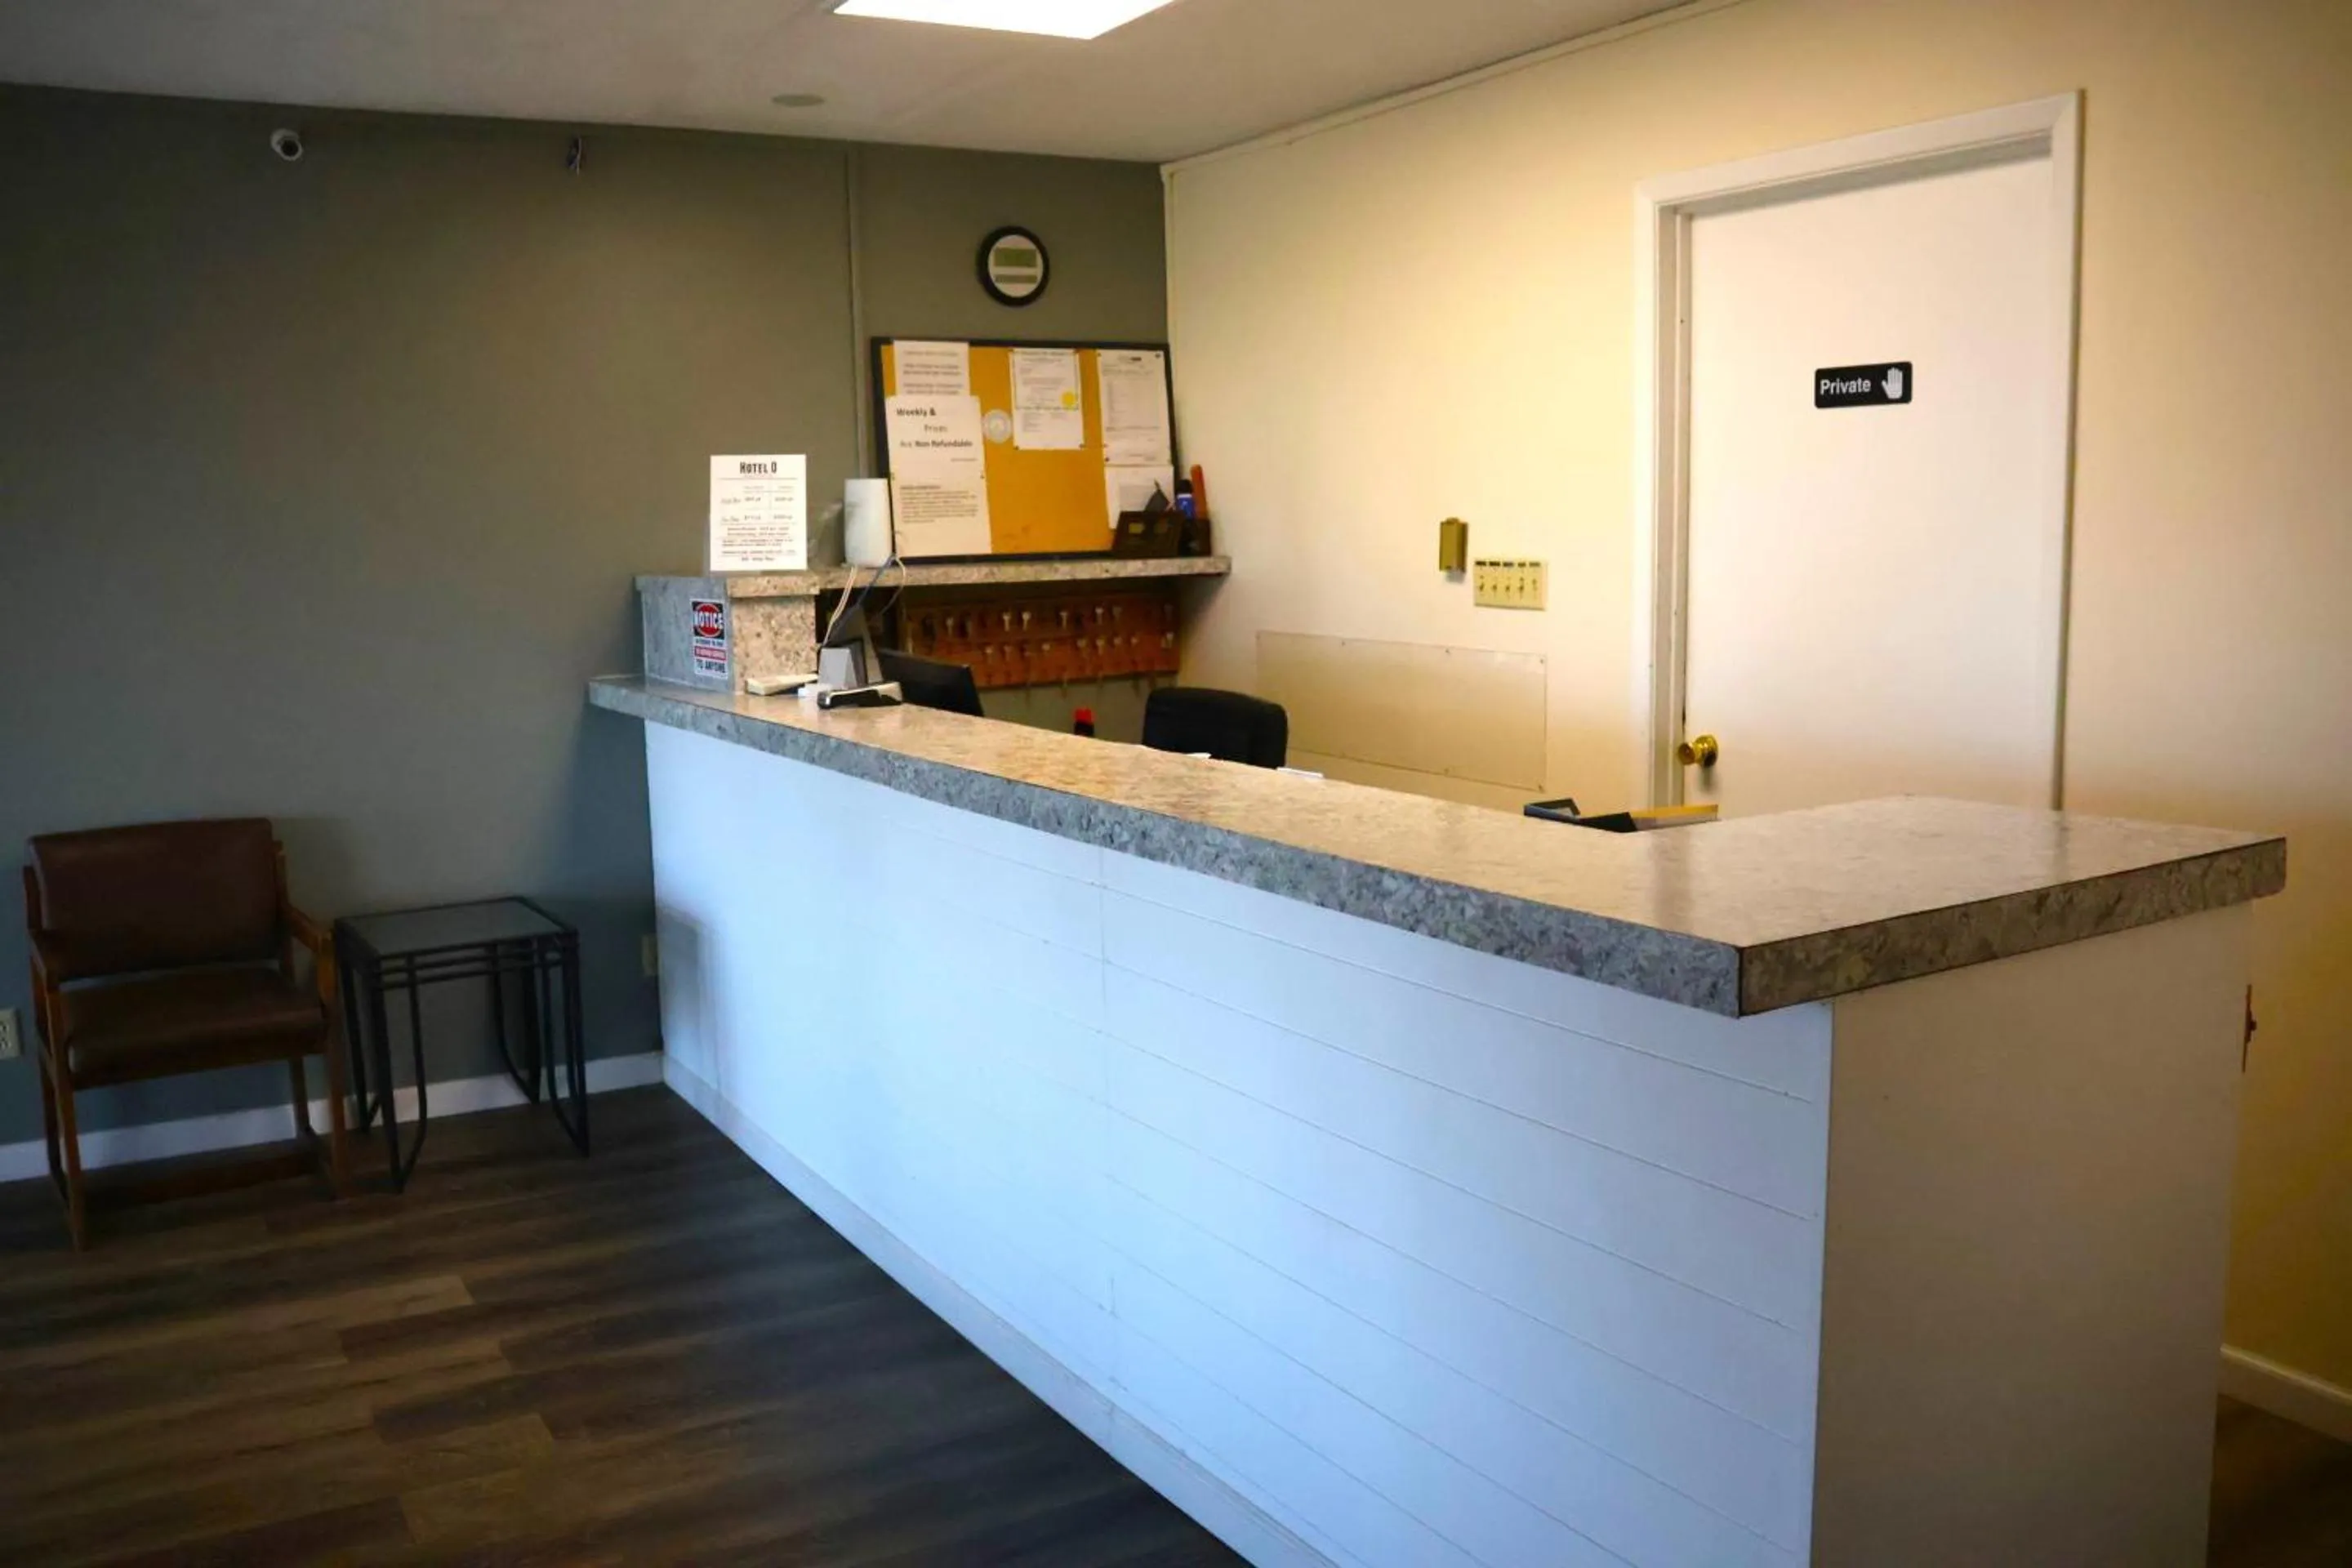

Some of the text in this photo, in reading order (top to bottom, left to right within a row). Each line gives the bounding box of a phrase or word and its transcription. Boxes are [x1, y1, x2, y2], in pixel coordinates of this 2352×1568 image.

[1820, 376, 1871, 395] Private
[897, 408, 927, 416] Weekly
[693, 610, 724, 630] NOTICE
